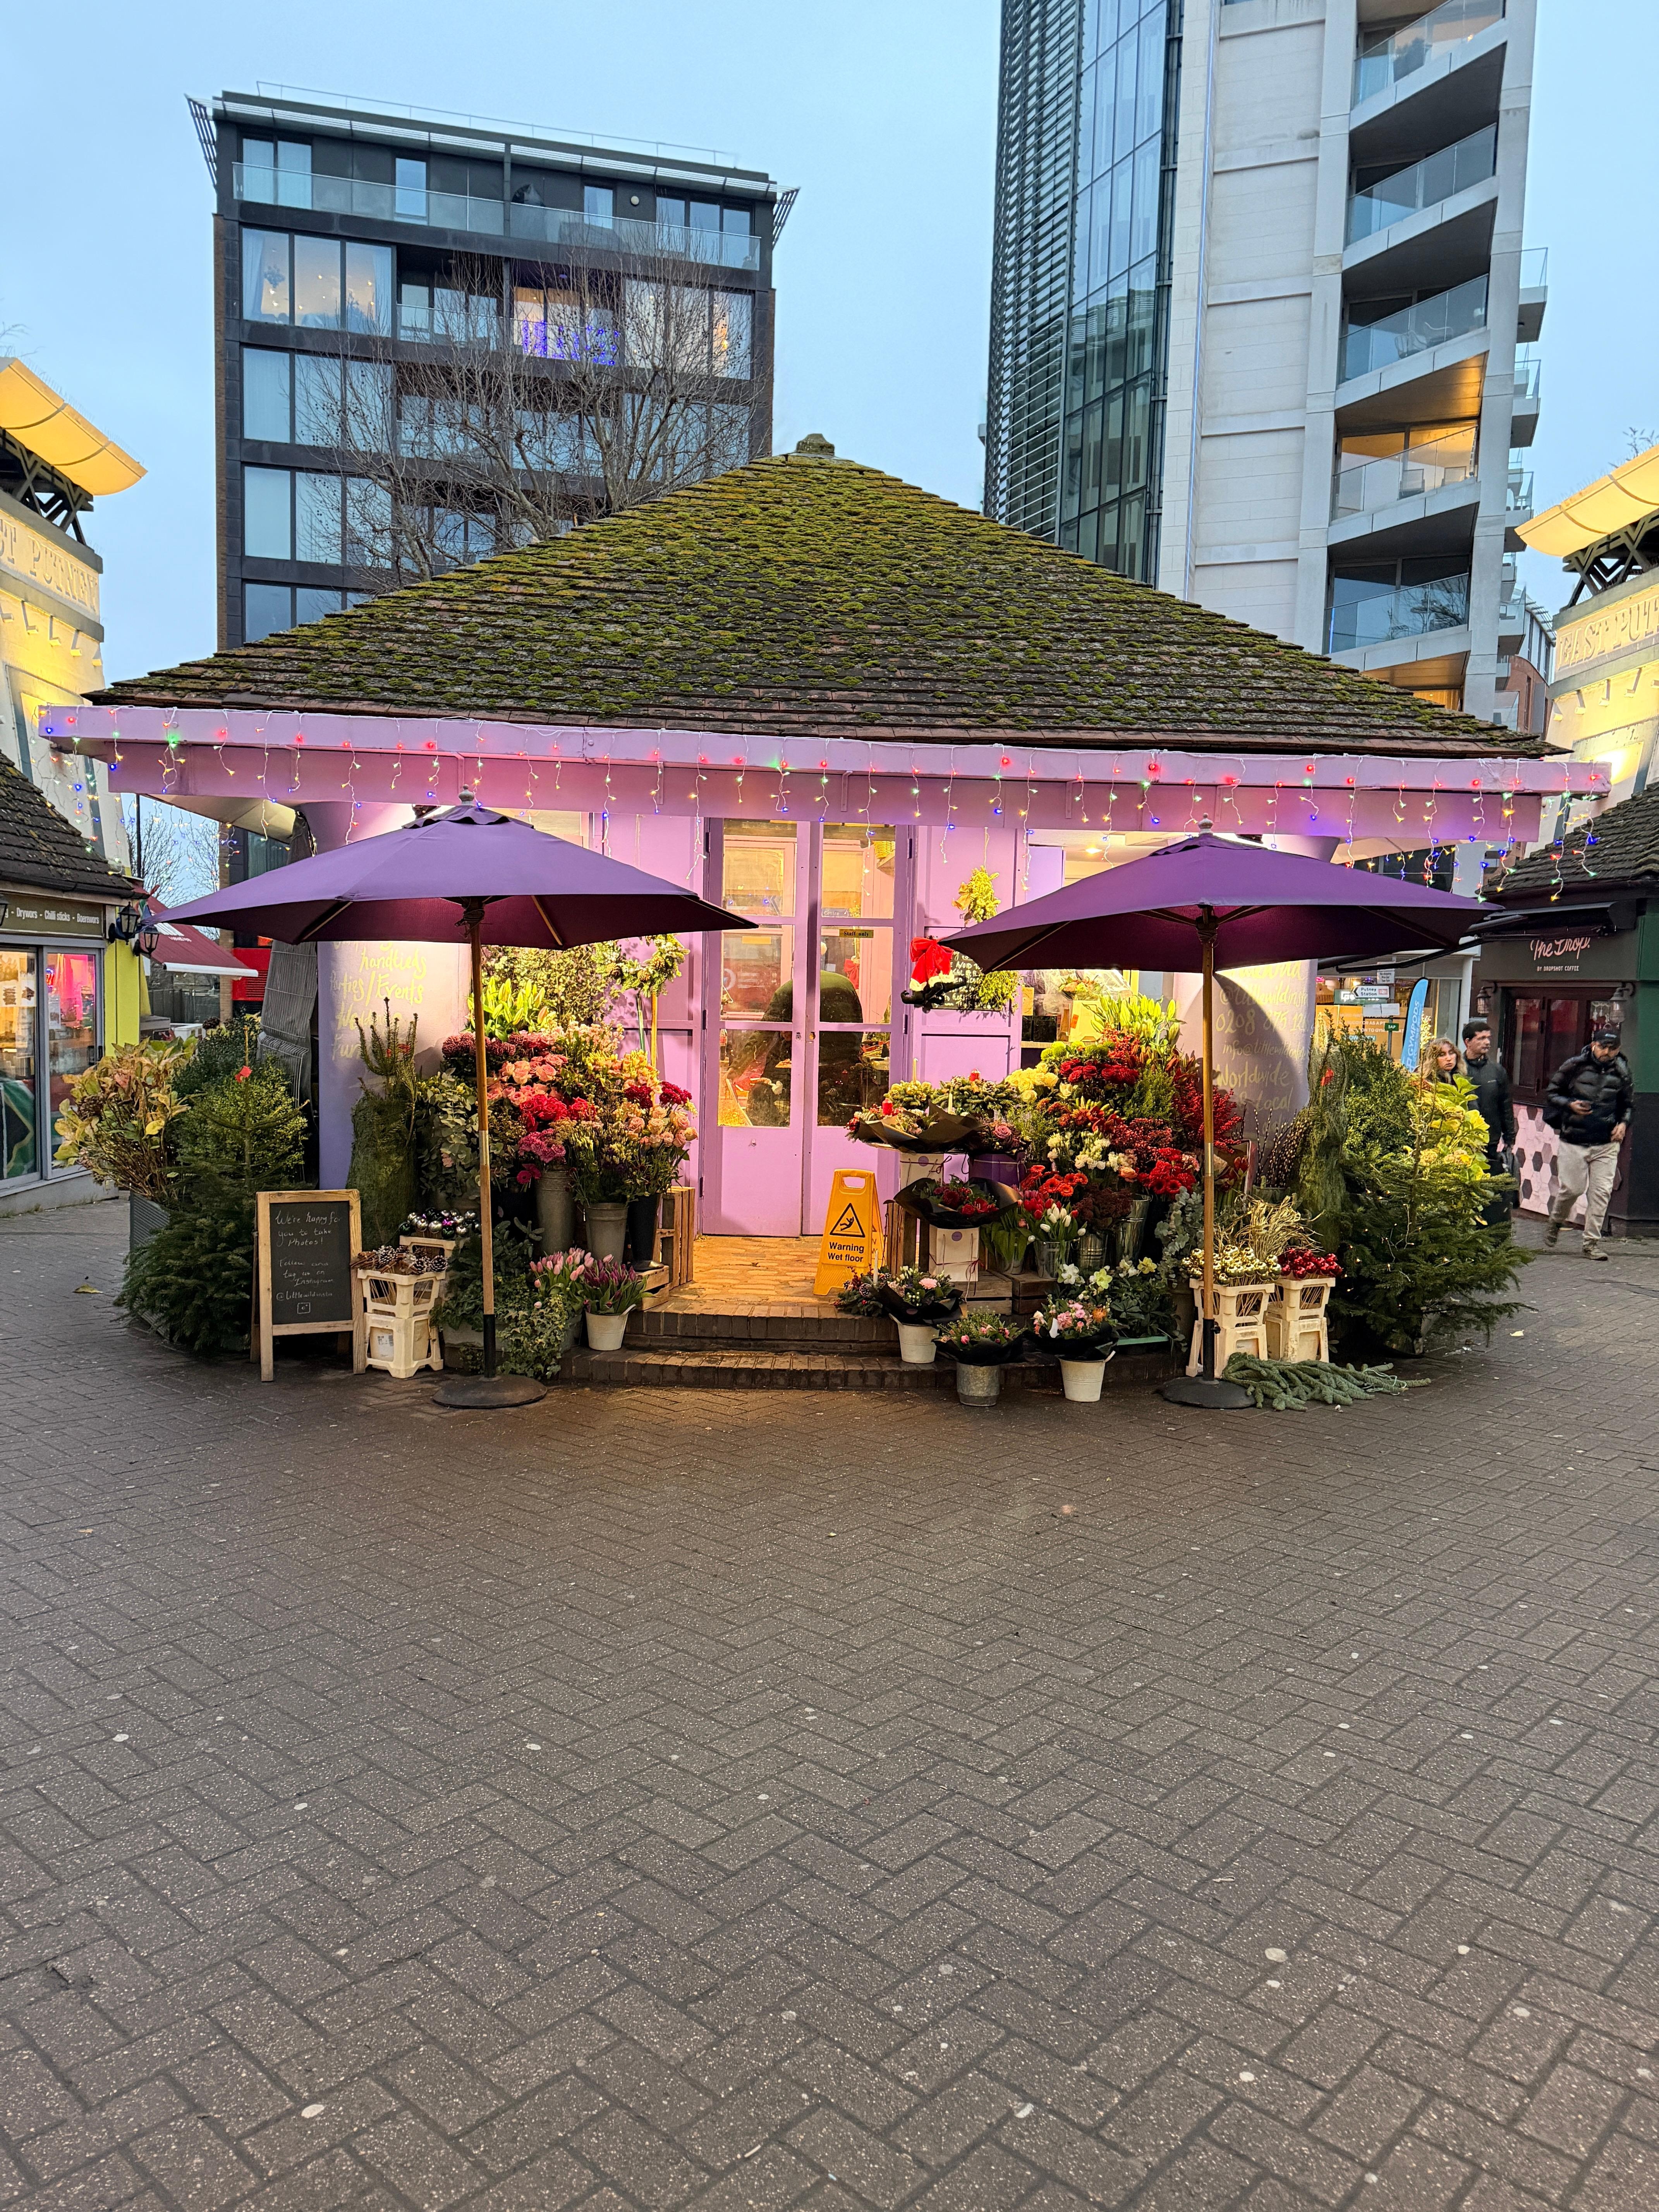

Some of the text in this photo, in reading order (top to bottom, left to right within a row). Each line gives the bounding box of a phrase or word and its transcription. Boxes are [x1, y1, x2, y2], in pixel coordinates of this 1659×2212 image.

[27, 535, 99, 613] PUTNEY
[1558, 594, 1659, 671] EAST PUT
[45, 910, 56, 921] Chilli
[57, 912, 70, 922] sticks
[1530, 939, 1553, 961] The
[1216, 1009, 1256, 1036] 0208
[1408, 1000, 1420, 1056] GYMPODS
[1216, 1059, 1290, 1088] Worldwide
[276, 1209, 342, 1225] We're happy for
[276, 1231, 294, 1247] you
[829, 1241, 864, 1254] Warning
[279, 1257, 304, 1267] Follow
[828, 1252, 864, 1262] Wet floor
[283, 1269, 296, 1281] tag
[294, 1278, 333, 1287] Instagram
